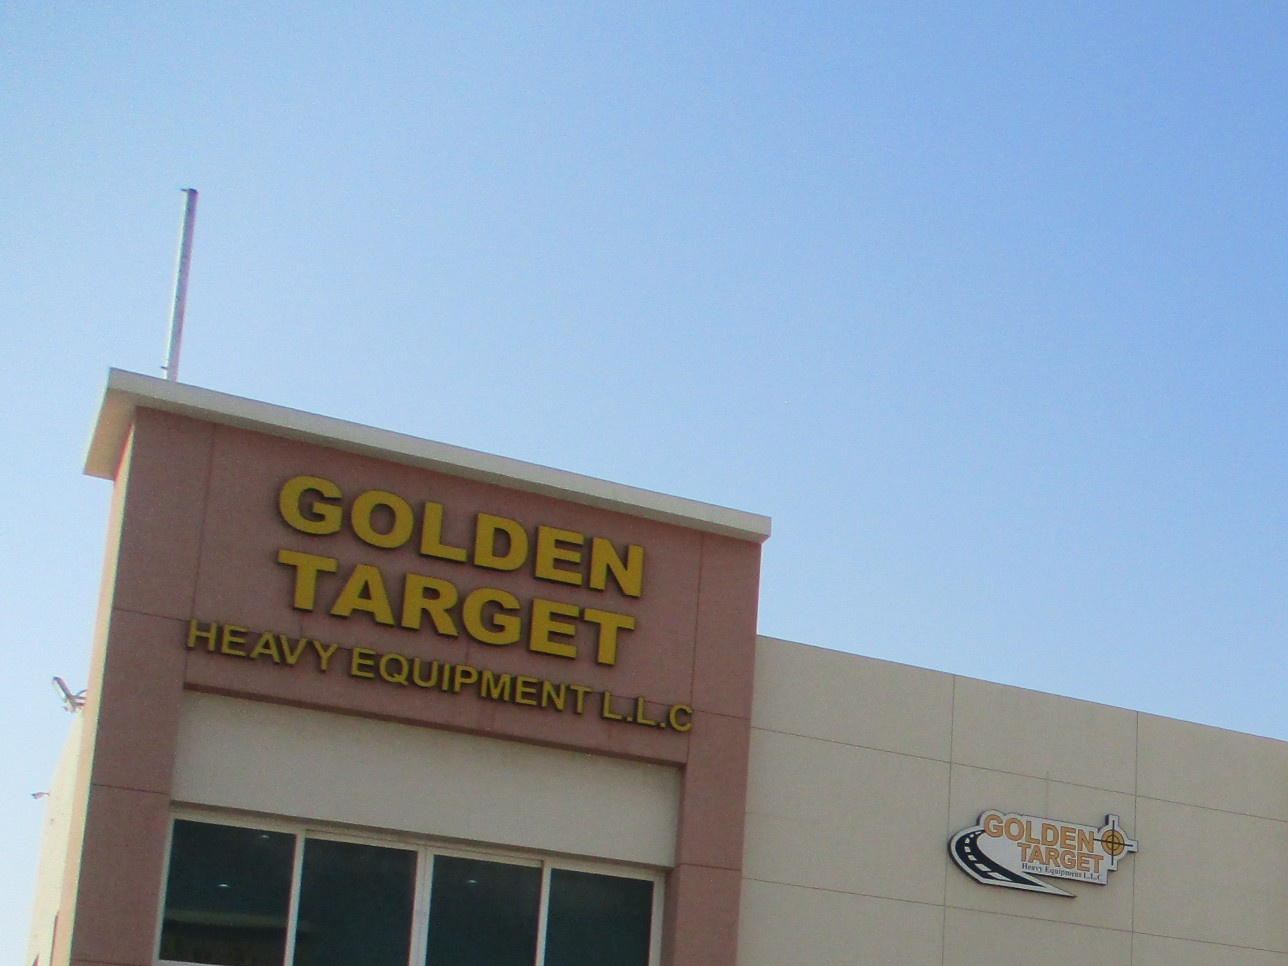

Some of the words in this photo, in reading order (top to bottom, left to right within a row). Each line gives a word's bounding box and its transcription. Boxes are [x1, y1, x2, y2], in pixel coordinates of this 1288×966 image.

[277, 475, 646, 598] GOLDEN
[277, 550, 638, 664] TARGET
[187, 618, 340, 671] HEAVY
[350, 645, 592, 714] EQUIPMENT
[602, 691, 694, 733] L.L.C
[984, 815, 1094, 853] GOLDEN
[1018, 843, 1104, 874] TARGET
[1021, 862, 1043, 873] Heavy
[1045, 866, 1082, 878] Equipment
